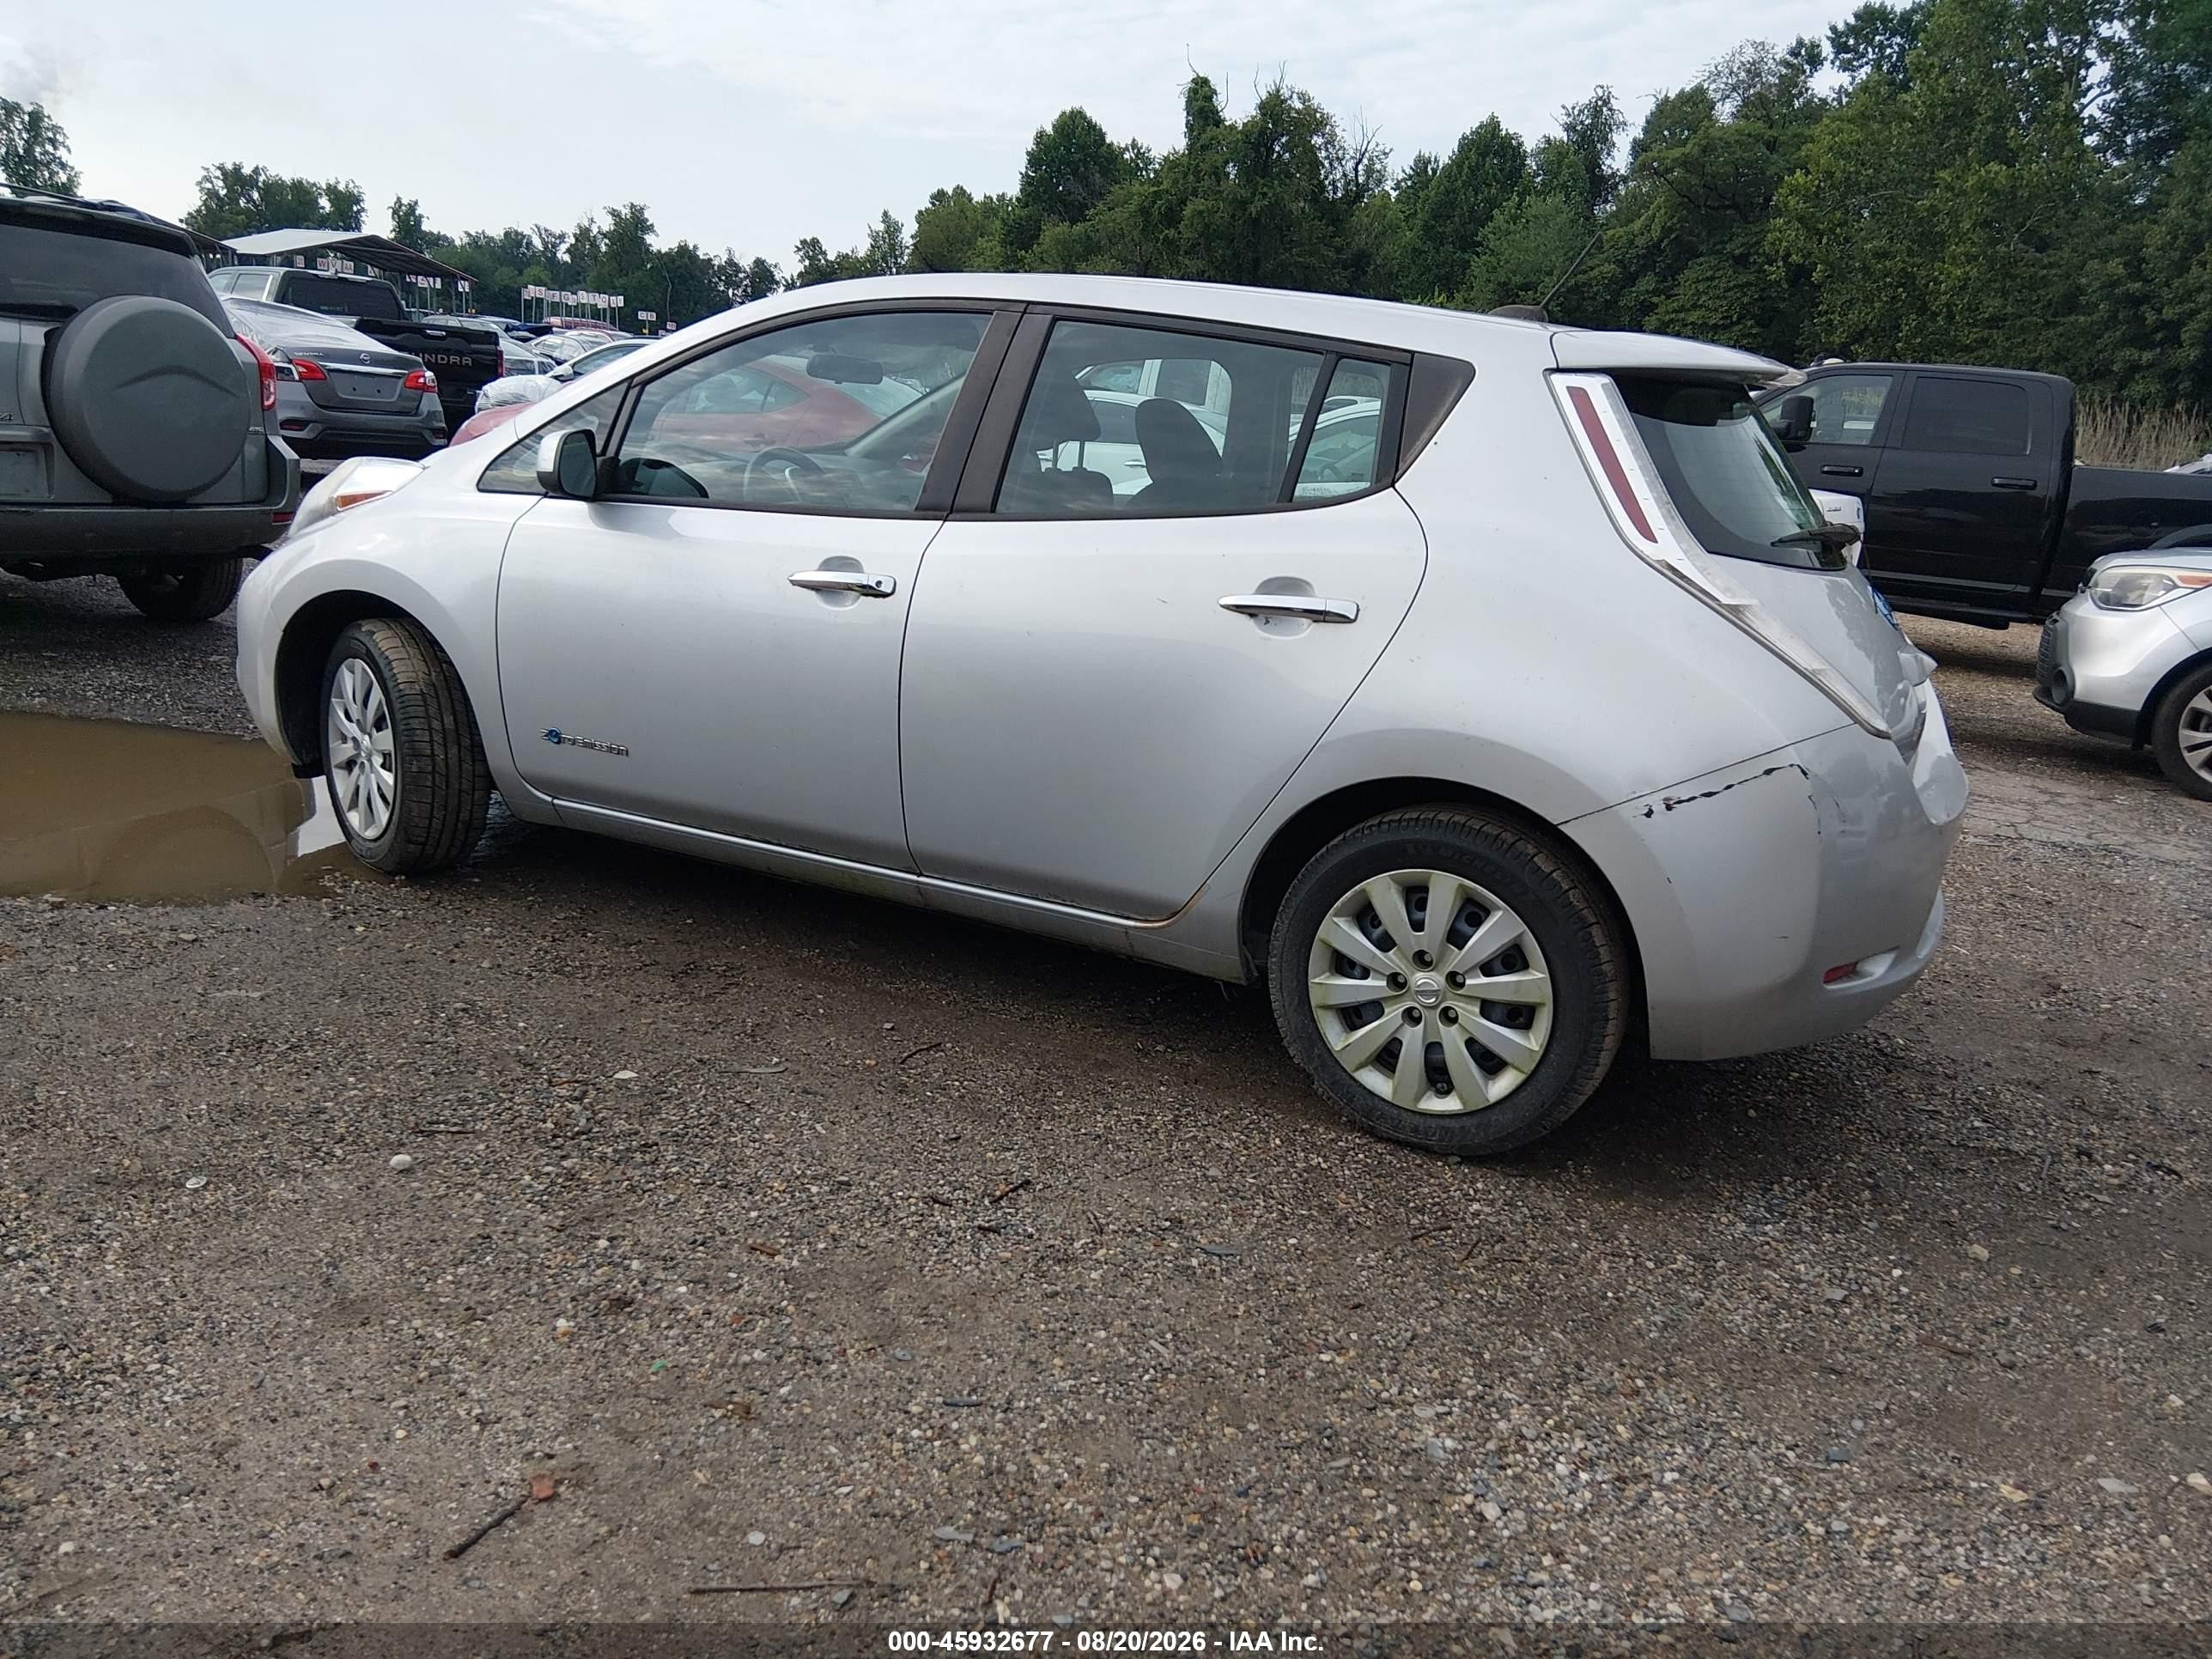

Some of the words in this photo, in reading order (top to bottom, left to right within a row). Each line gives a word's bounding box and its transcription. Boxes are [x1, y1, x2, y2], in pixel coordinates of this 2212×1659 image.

[318, 259, 326, 268] W
[344, 262, 353, 270] AA
[538, 288, 544, 296] S
[407, 351, 472, 367] NDRA
